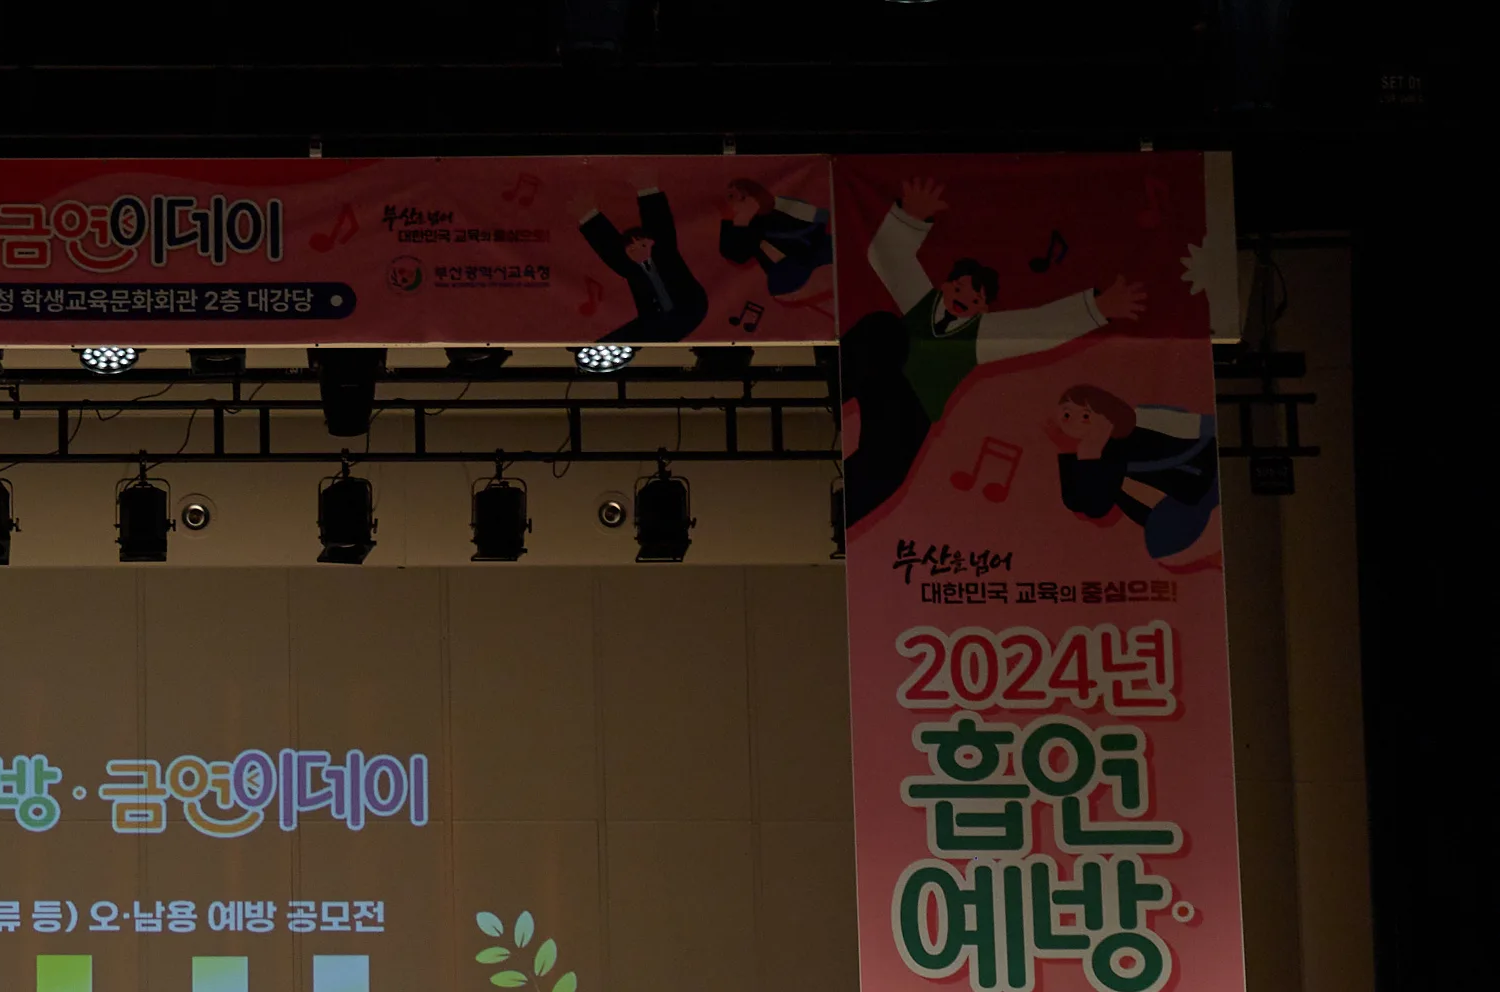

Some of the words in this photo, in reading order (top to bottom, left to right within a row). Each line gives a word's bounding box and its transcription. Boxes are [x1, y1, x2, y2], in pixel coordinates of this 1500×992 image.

[435, 265, 550, 281] 부산광역시교육청
[20, 286, 199, 315] 학생교육문화회관
[204, 287, 243, 314] 2층
[247, 286, 315, 314] 대강당
[892, 539, 967, 586] 부산을
[968, 549, 1013, 577] 넘어
[920, 581, 1009, 605] 대한민국
[1015, 580, 1077, 604] 교육의
[1080, 579, 1178, 604] 중심으로!
[899, 624, 1172, 712] 2024년
[99, 749, 427, 838] 금연이데이
[904, 713, 1179, 855] 흡연
[31, 898, 80, 935] 등)
[88, 898, 198, 933] 오·남용
[207, 897, 277, 933] 예방
[285, 897, 386, 933] 공모전
